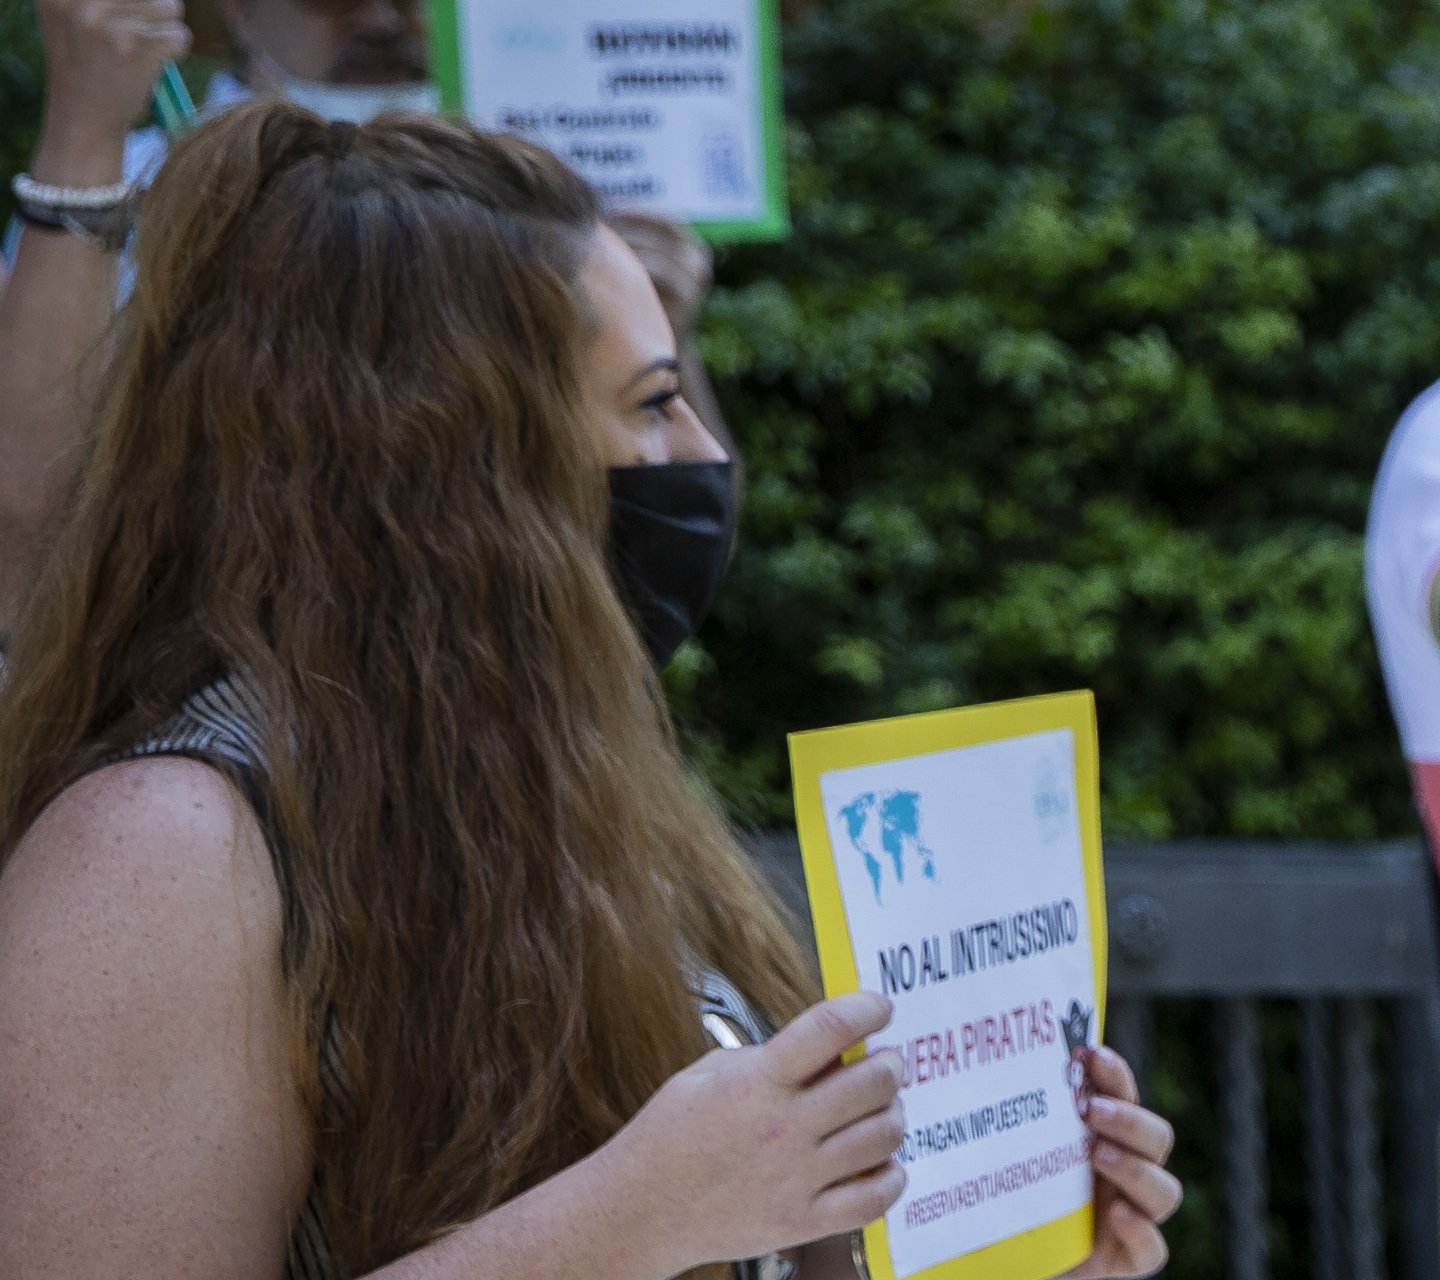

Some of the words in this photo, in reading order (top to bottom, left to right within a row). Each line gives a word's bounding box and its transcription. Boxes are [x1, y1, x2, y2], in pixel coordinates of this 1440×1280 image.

[878, 944, 916, 996] NO
[920, 935, 949, 988] AL
[950, 897, 1078, 977] INTRUSISMO
[961, 998, 1056, 1069] PIRATAS
[914, 1116, 968, 1159] PAGAN
[969, 1088, 1049, 1141] IMPUESTOS
